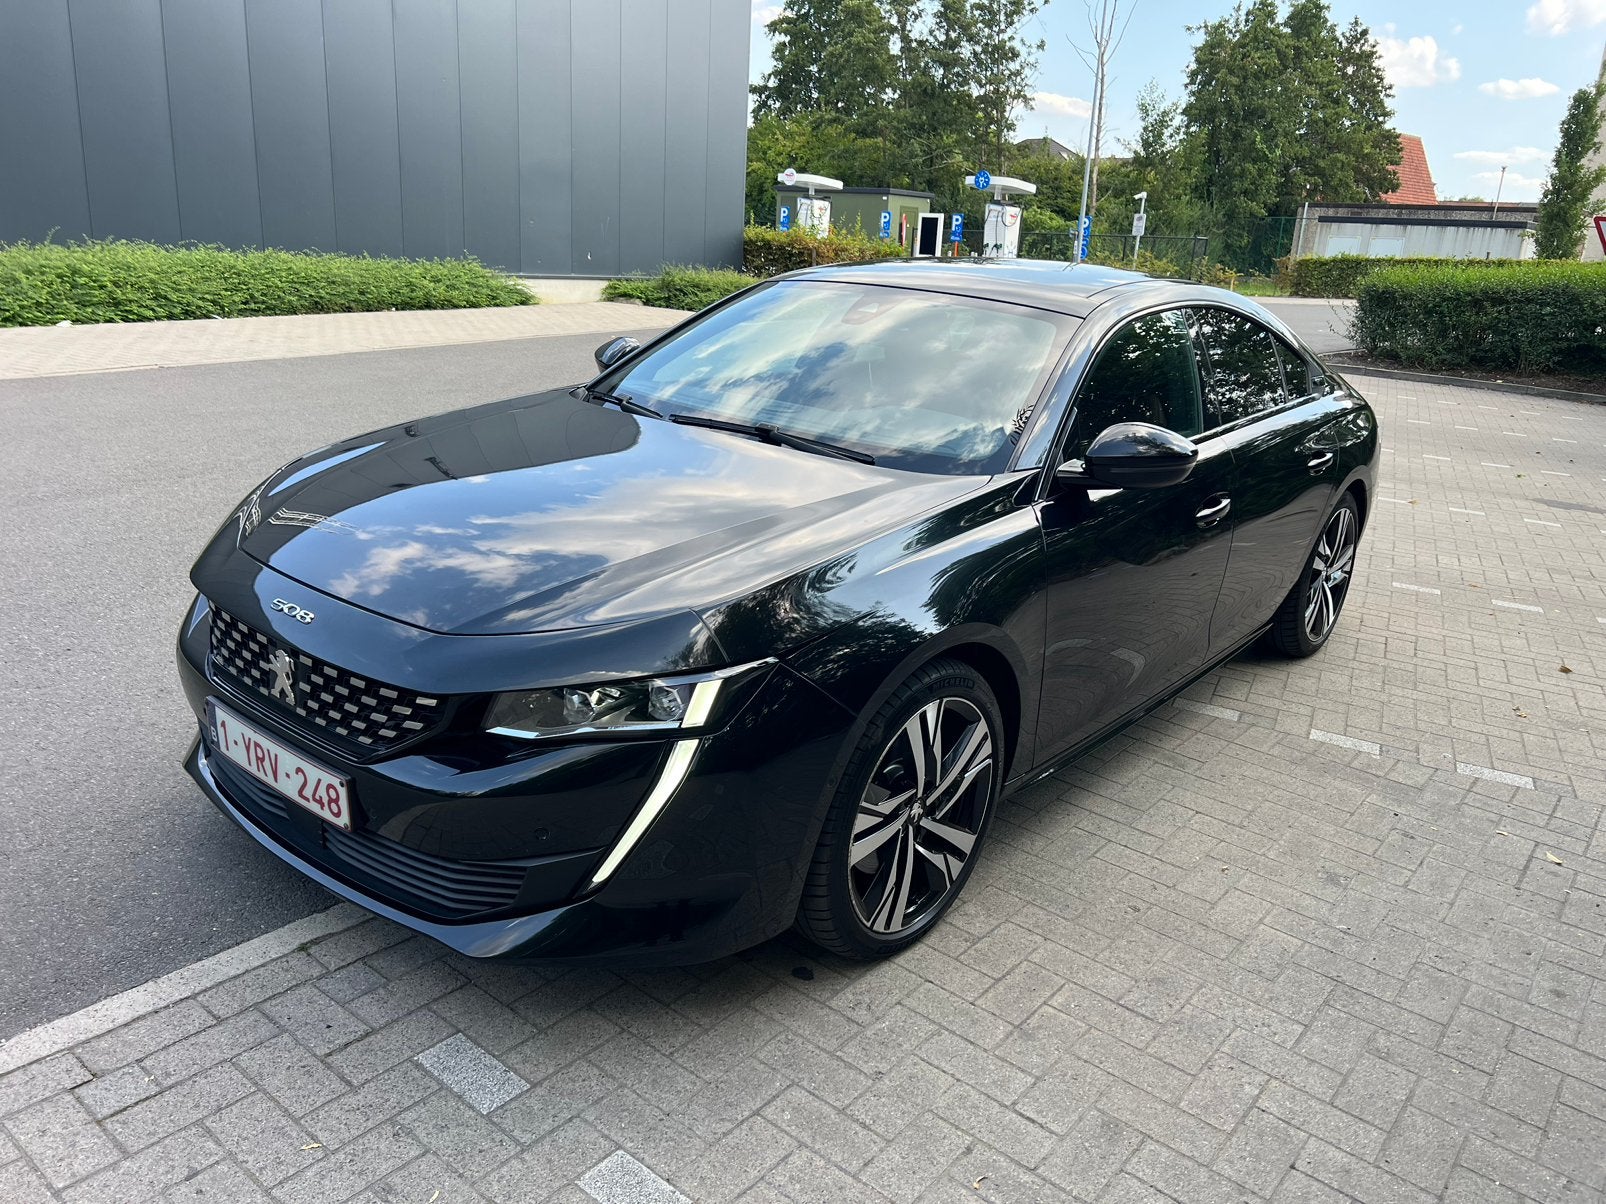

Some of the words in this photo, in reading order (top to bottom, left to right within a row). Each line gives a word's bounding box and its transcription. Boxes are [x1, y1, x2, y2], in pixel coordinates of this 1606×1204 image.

[780, 207, 788, 222] P
[881, 212, 890, 228] P
[952, 215, 962, 231] P
[270, 598, 316, 625] 508
[211, 725, 218, 742] B
[219, 719, 342, 819] 1-YRV-248
